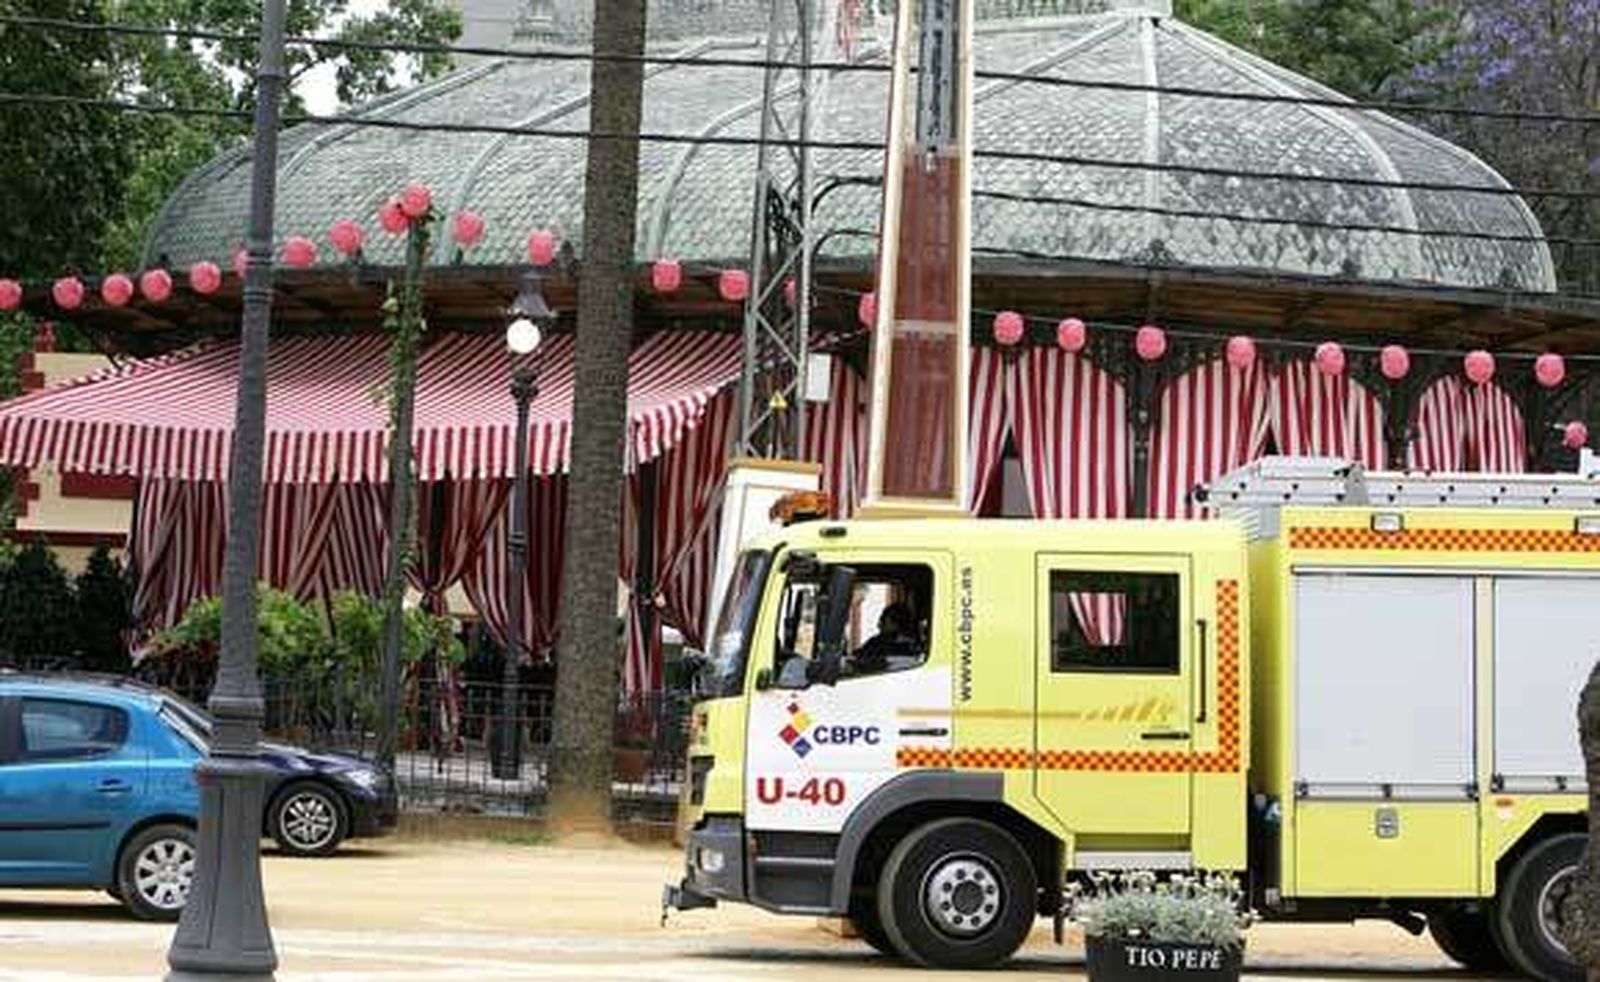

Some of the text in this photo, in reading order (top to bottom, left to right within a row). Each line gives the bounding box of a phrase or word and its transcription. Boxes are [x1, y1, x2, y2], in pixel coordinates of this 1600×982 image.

[812, 726, 881, 745] CBPC
[757, 776, 846, 805] U-40
[1125, 946, 1222, 969] TIO PEPE
